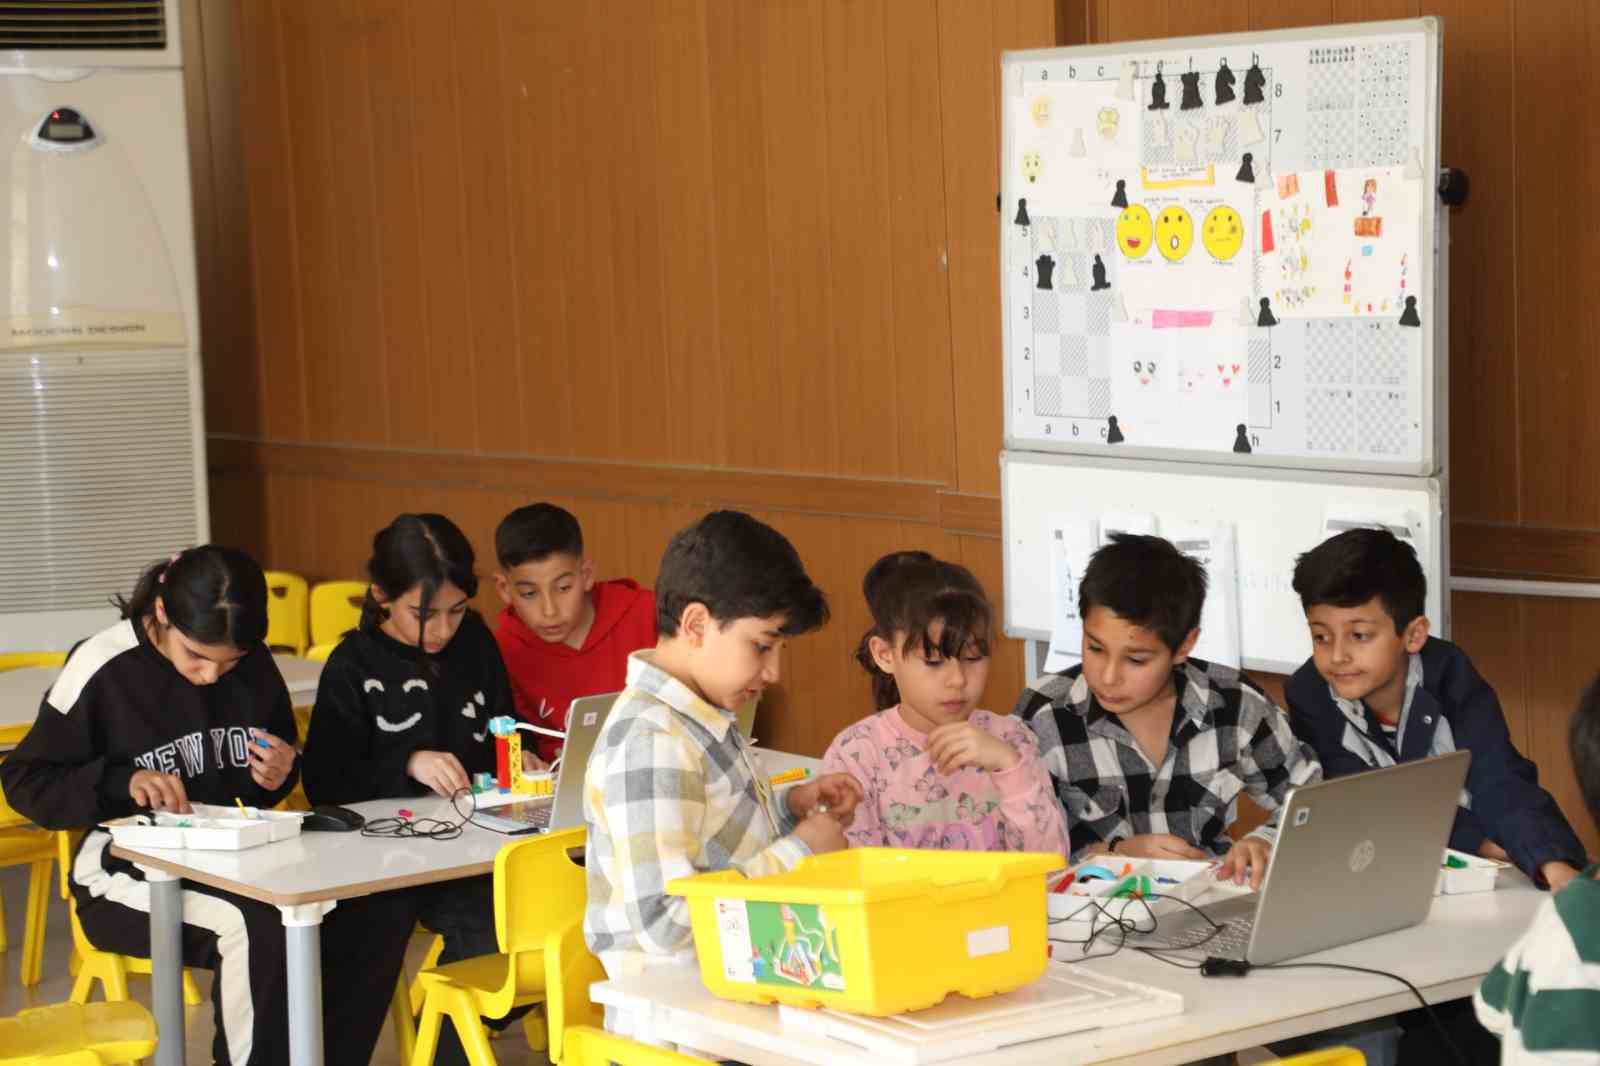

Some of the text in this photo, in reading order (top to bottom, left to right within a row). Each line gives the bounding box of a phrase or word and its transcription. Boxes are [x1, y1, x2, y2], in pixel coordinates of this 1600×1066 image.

[1068, 64, 1077, 80] b
[1274, 83, 1283, 98] 8
[1273, 128, 1282, 143] 7
[1023, 305, 1030, 320] 3
[1023, 345, 1031, 361] 2
[1273, 354, 1282, 370] 2
[1273, 399, 1281, 415] 1
[1072, 423, 1080, 437] b
[1251, 432, 1260, 447] h
[209, 726, 268, 770] YO
